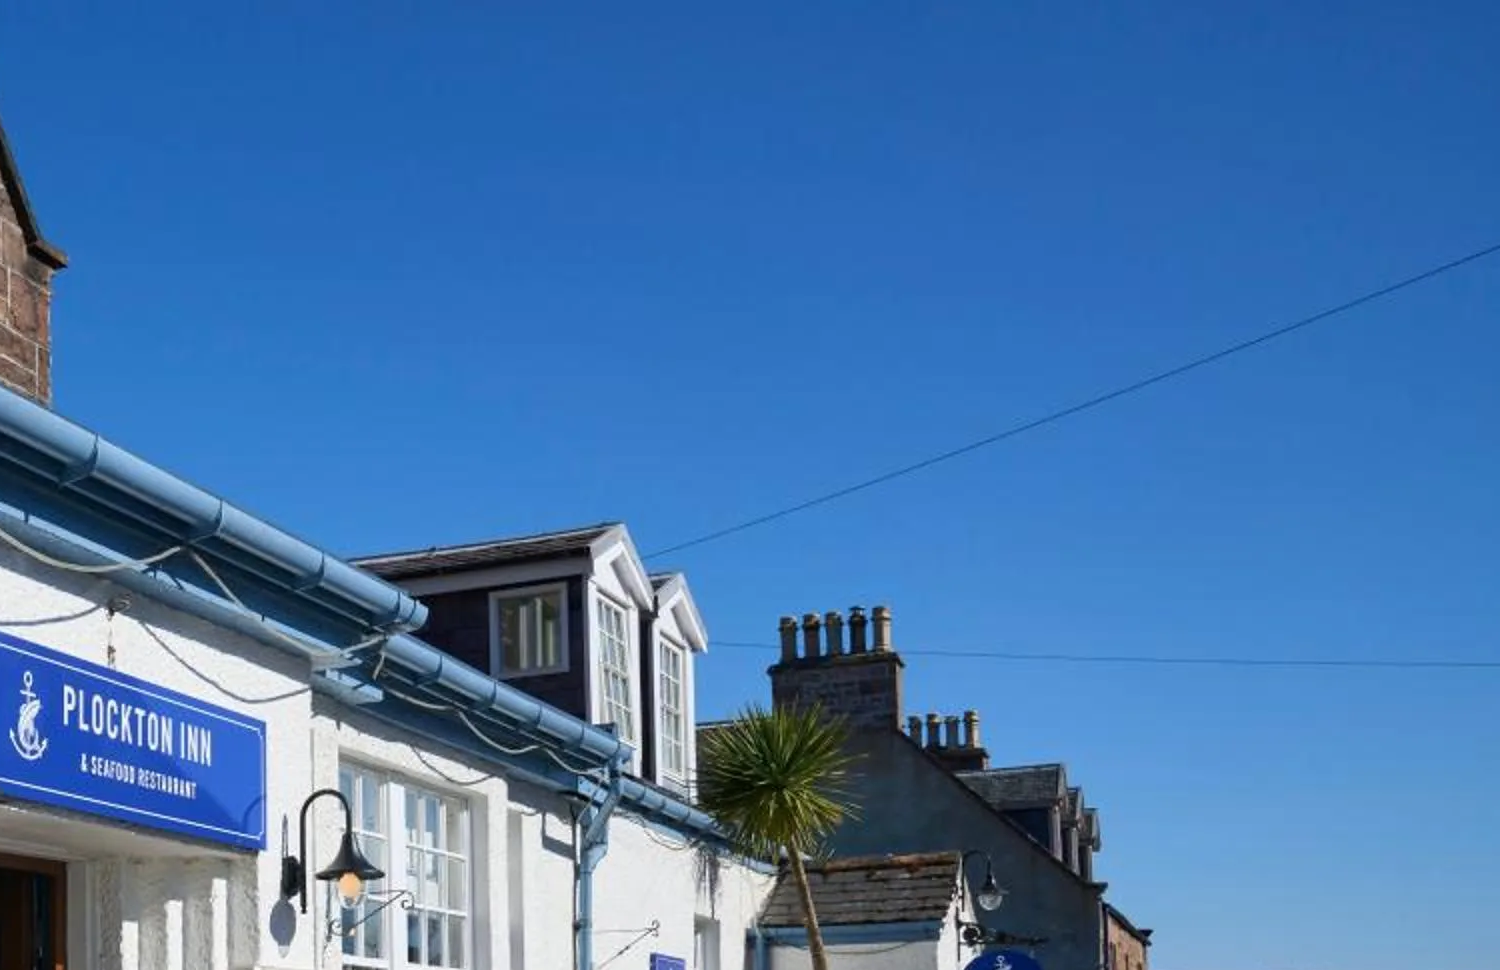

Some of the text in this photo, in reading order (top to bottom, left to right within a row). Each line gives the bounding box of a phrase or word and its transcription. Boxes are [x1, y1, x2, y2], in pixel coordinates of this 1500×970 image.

[63, 684, 211, 767] PLOCKTON INN
[81, 753, 197, 799] & SEAFOOD RESTAURANT
